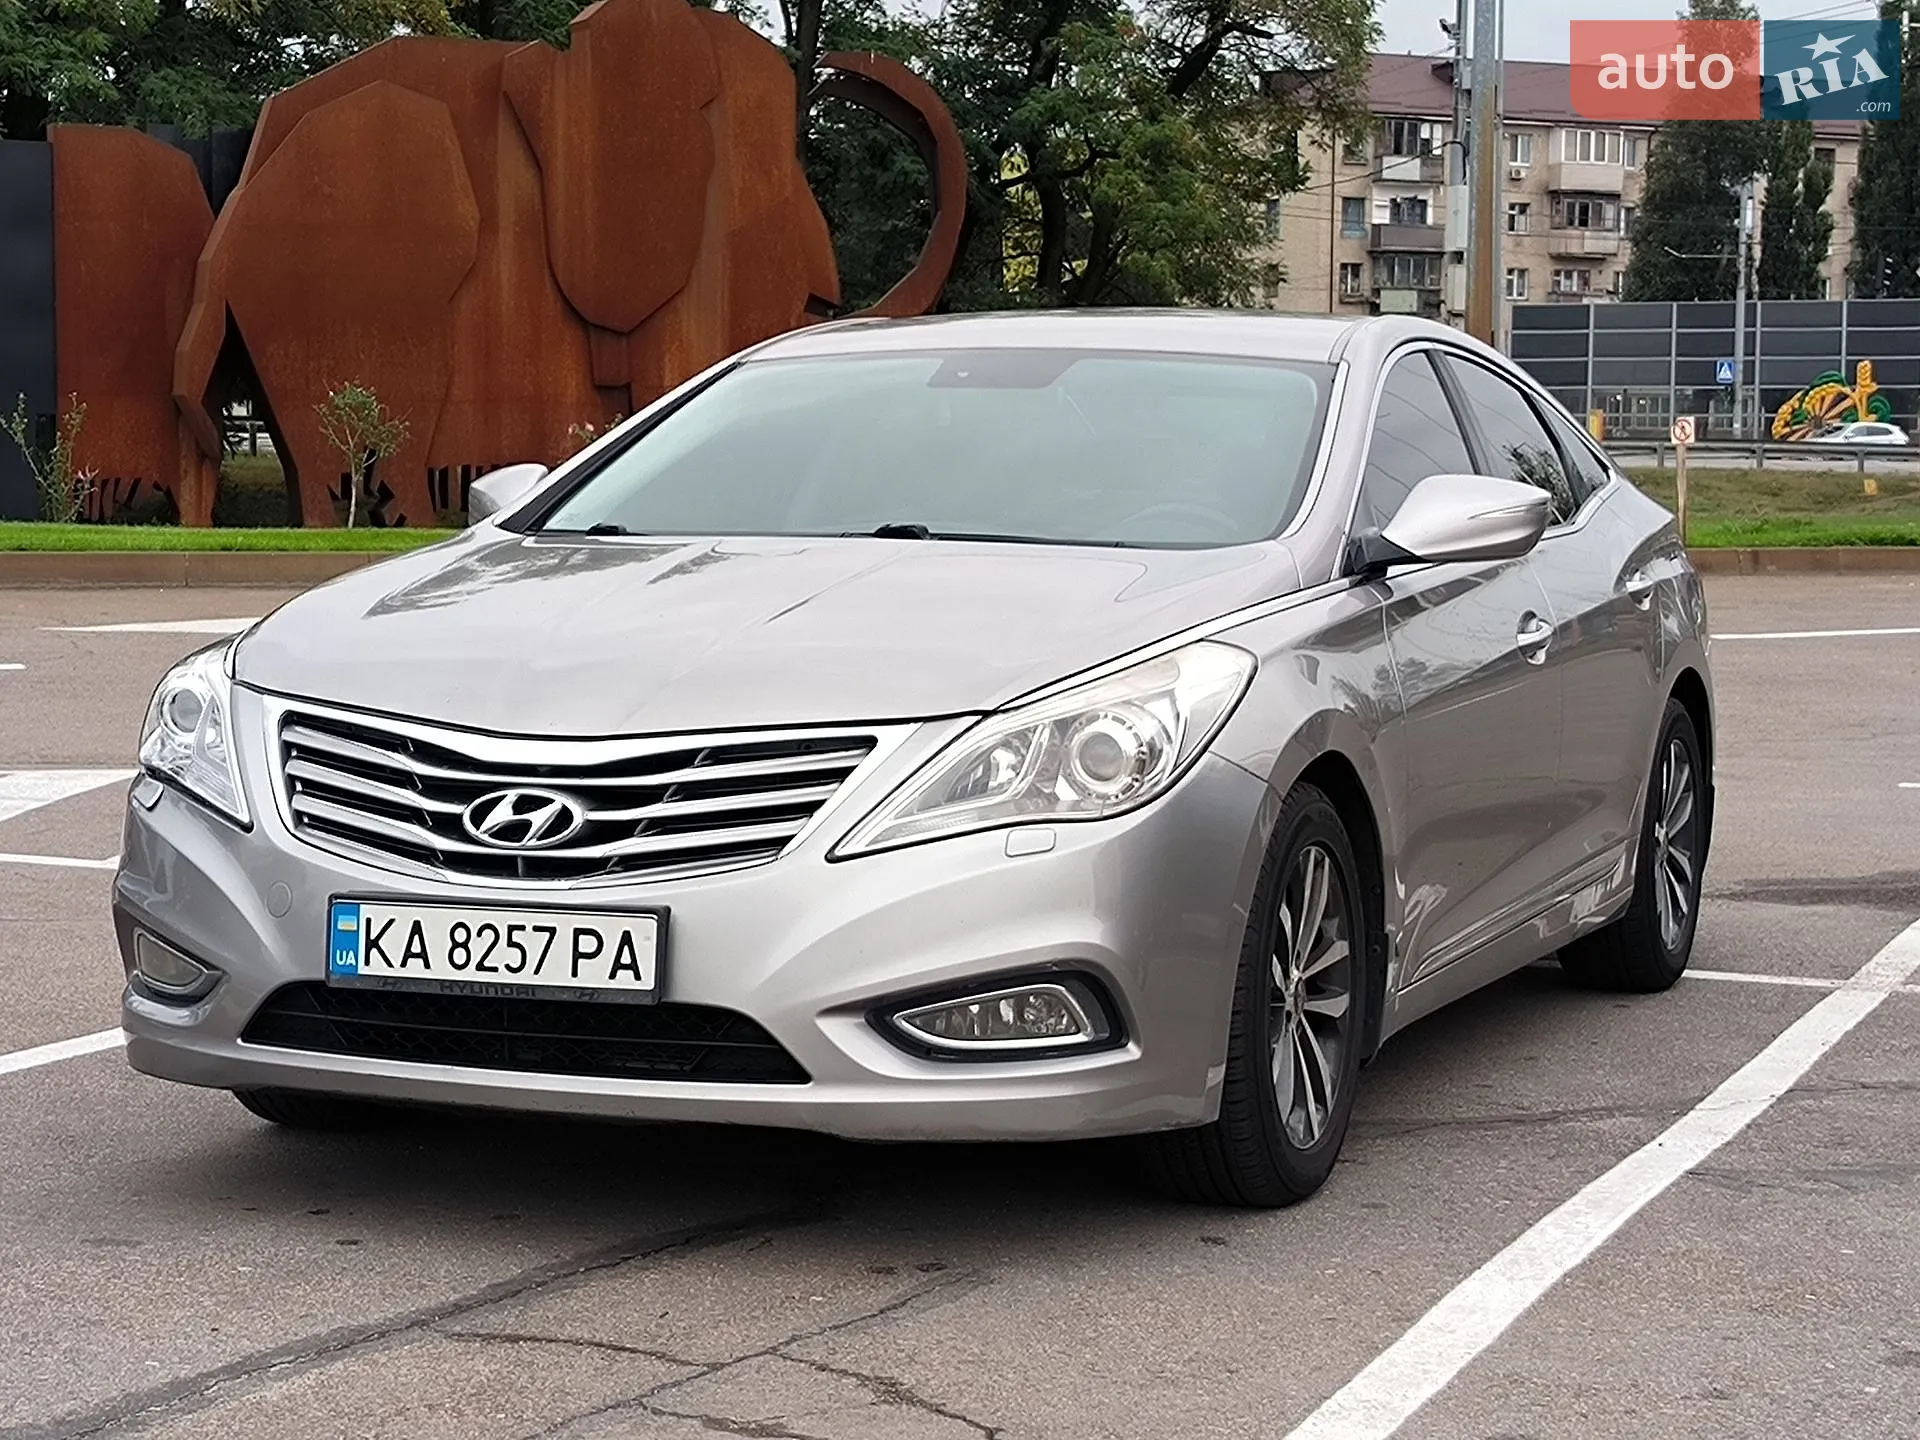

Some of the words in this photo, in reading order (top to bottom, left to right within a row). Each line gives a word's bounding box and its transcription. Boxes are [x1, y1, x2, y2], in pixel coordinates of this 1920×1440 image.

[336, 949, 357, 967] UA
[363, 916, 433, 970] KA
[447, 921, 558, 976] 8257
[570, 927, 642, 982] PA
[438, 980, 537, 998] HYUNDAI
